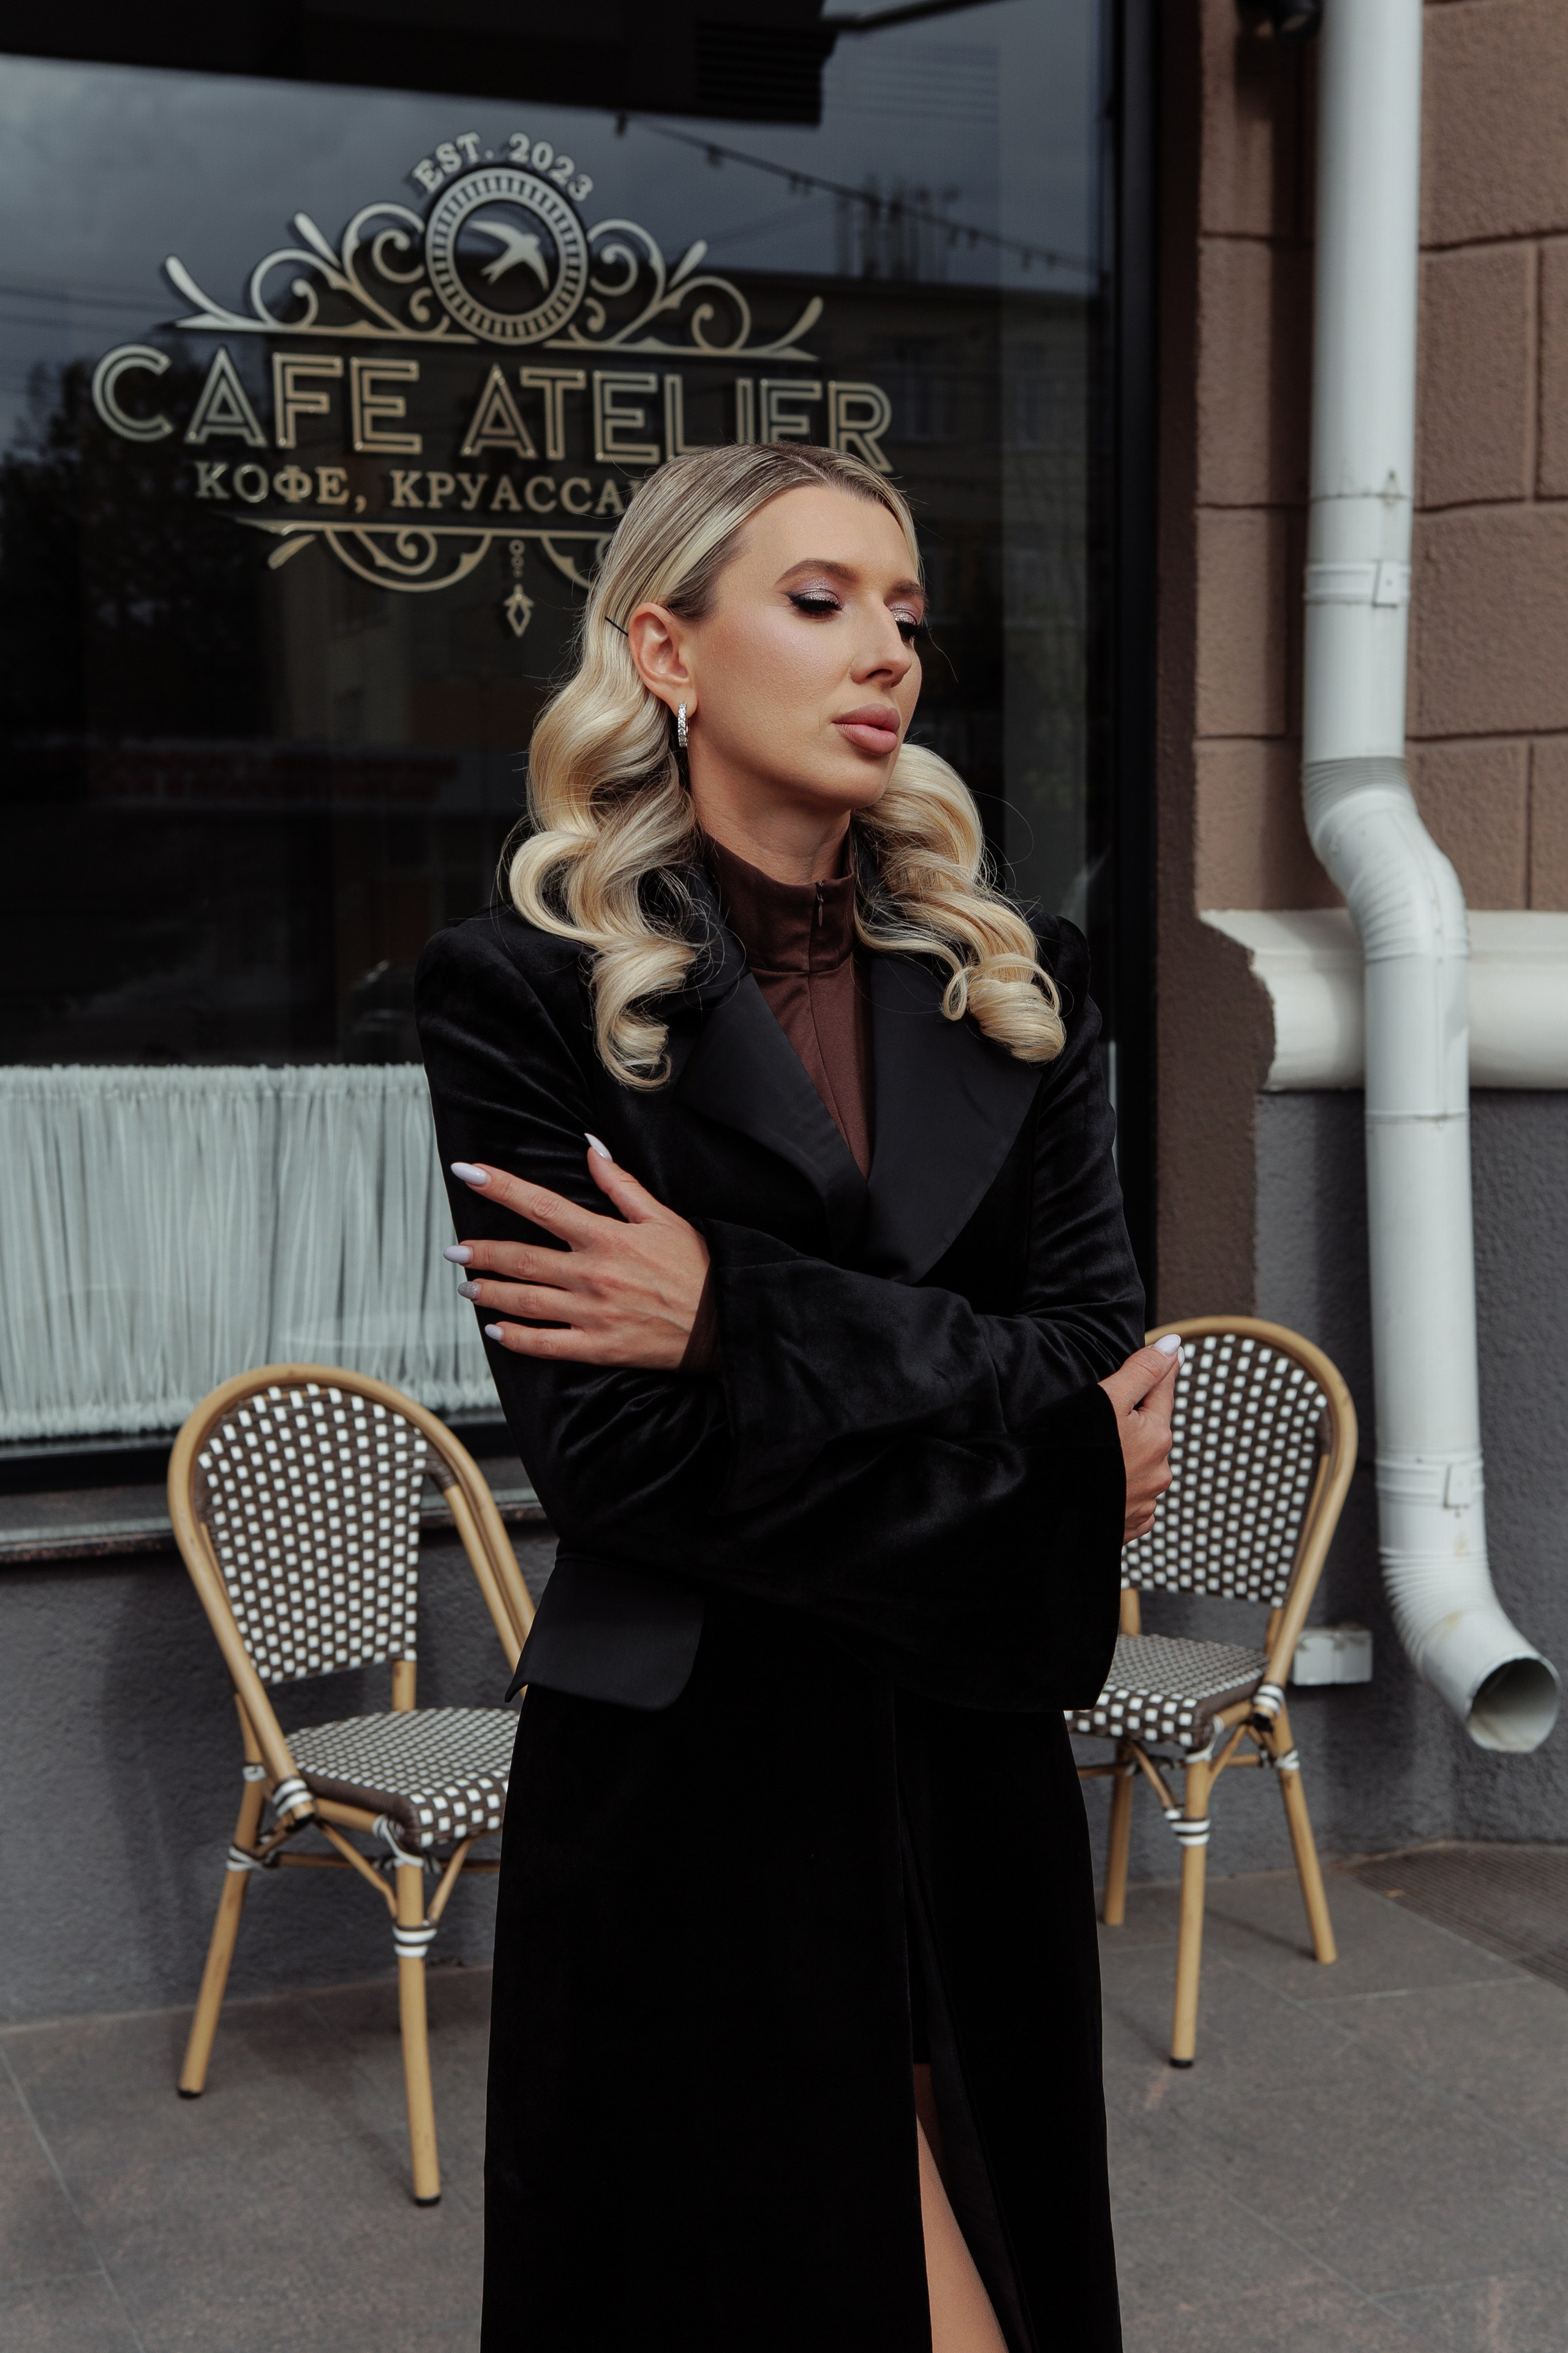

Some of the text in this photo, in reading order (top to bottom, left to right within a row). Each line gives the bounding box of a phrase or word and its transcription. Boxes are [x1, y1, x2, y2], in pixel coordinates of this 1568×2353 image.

[411, 130, 594, 202] EST. 2023
[92, 344, 892, 472] CAFE ATELIER
[194, 461, 367, 513] КОФЕ,
